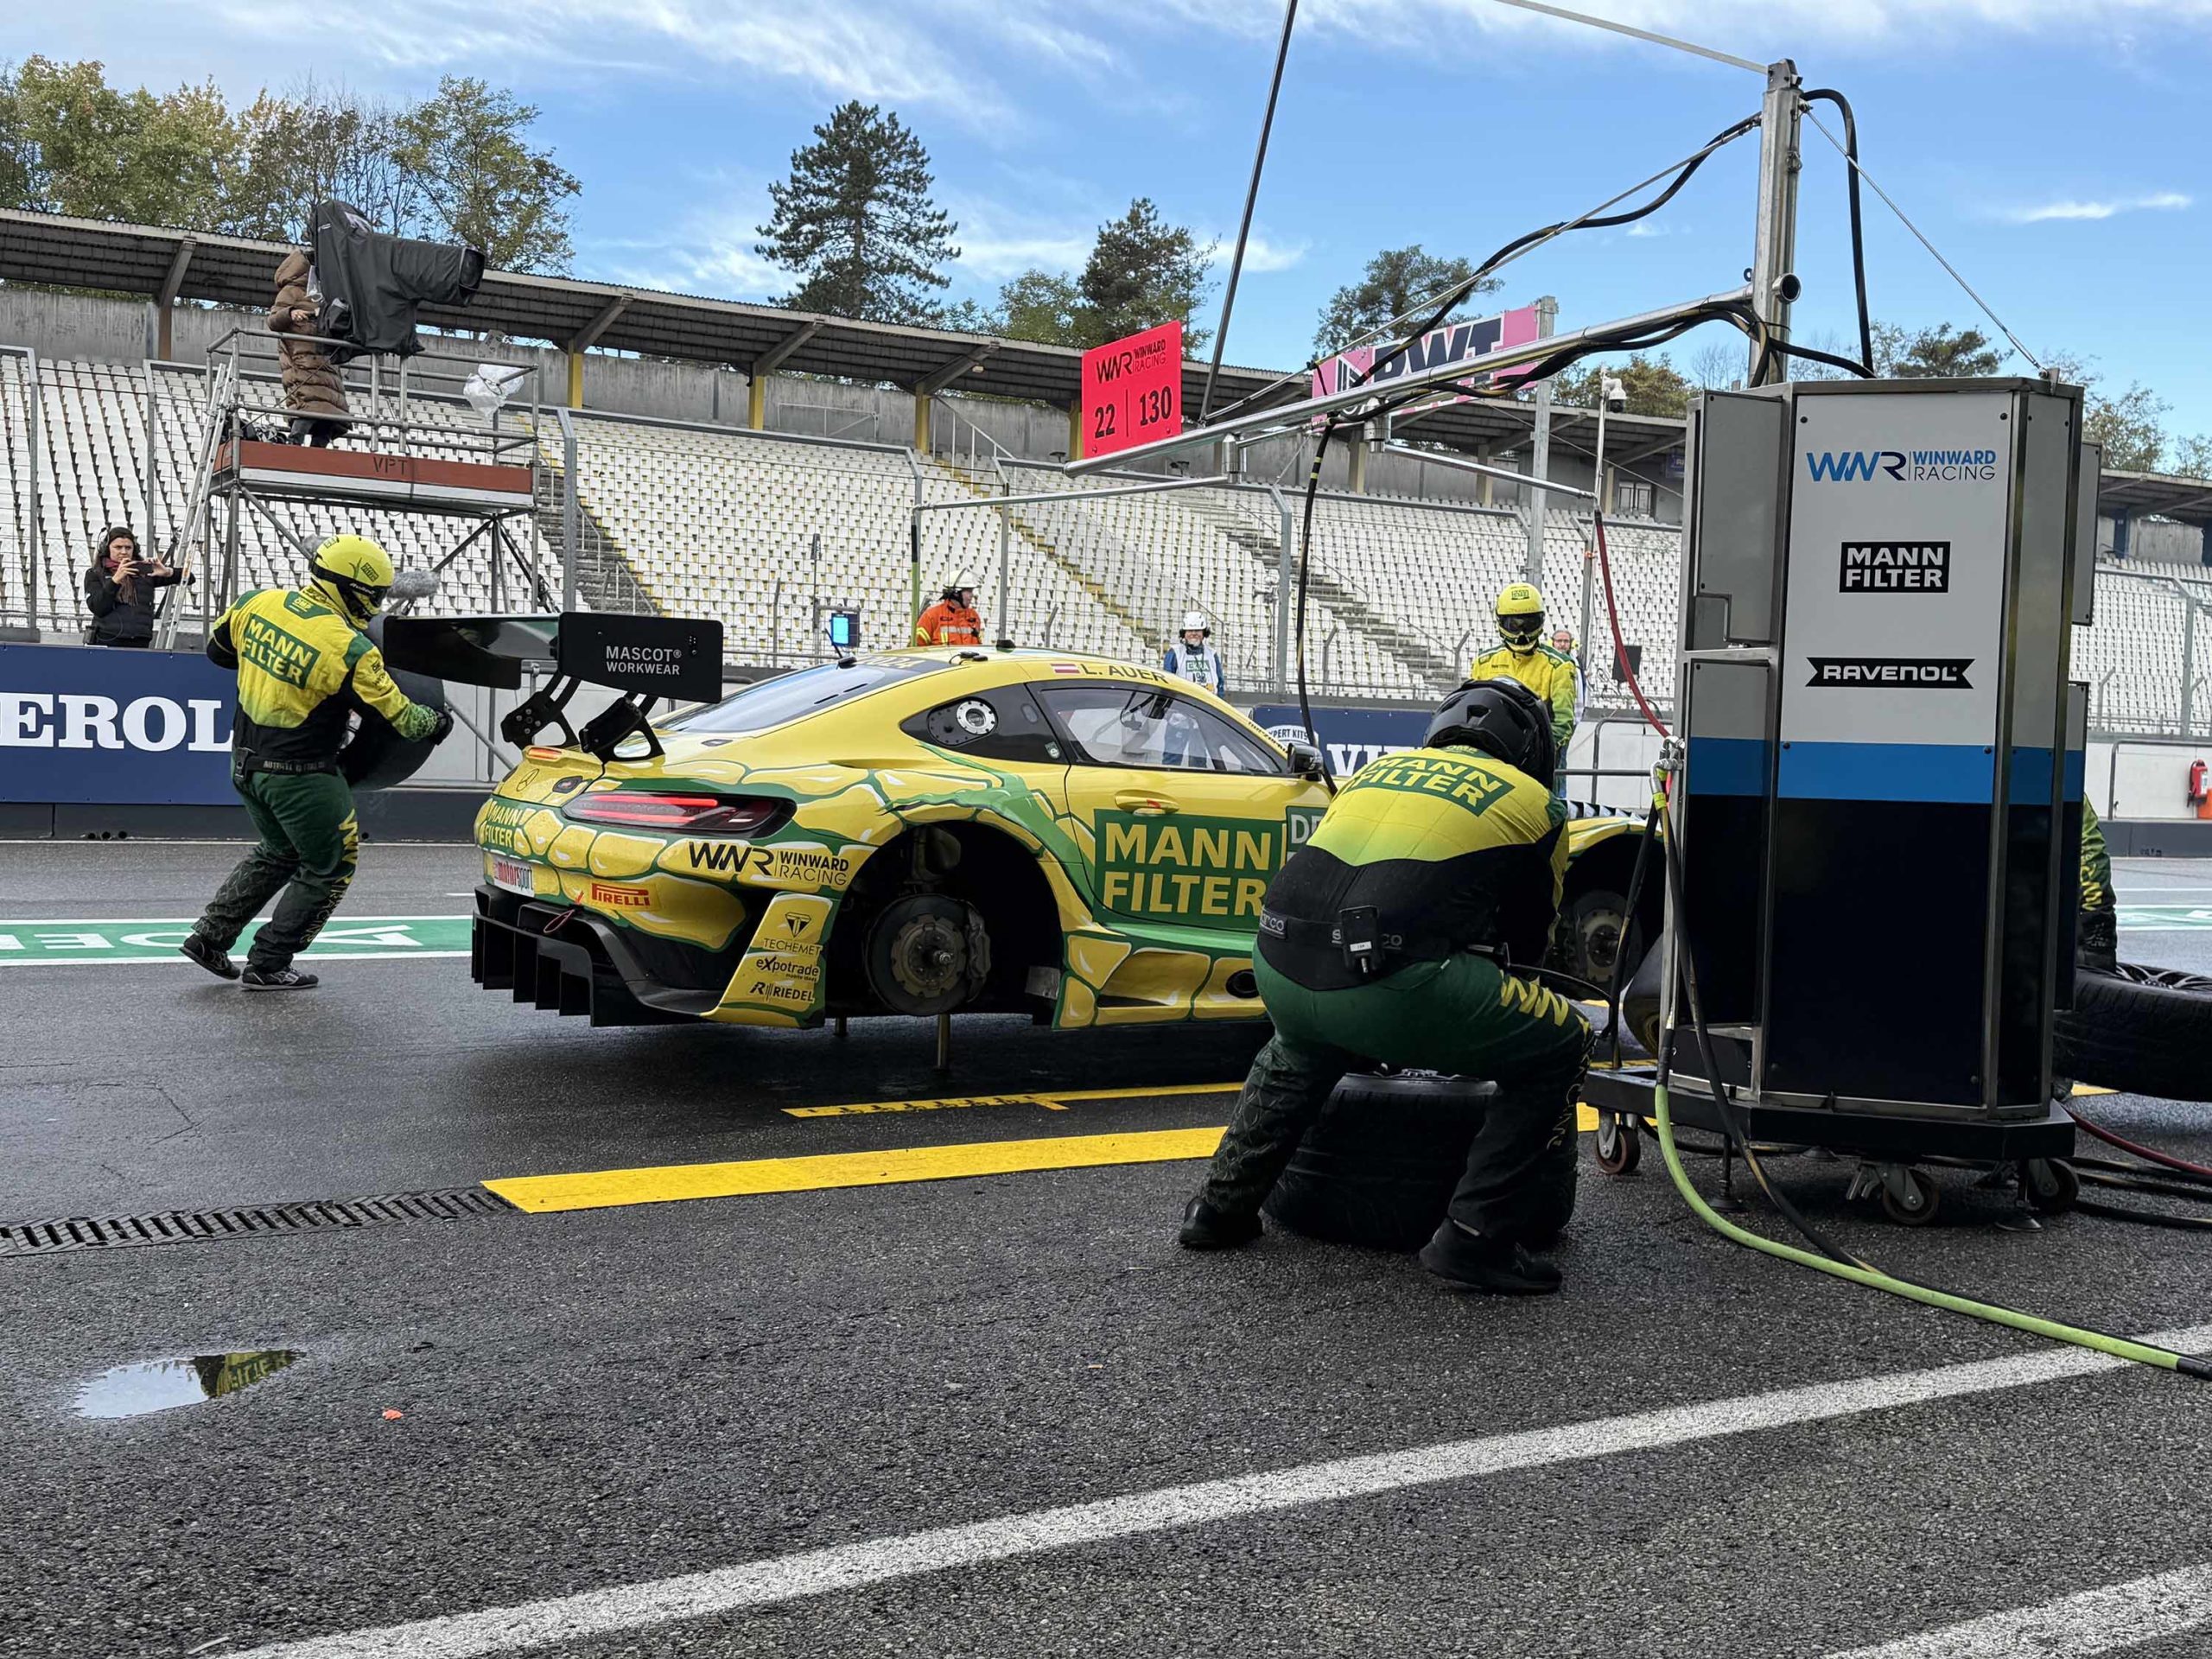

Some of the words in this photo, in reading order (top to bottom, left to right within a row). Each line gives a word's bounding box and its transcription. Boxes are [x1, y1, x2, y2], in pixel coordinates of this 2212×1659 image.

[1134, 339, 1166, 359] WINWARD
[1135, 352, 1166, 372] RACING
[1140, 385, 1173, 426] 130
[1095, 404, 1116, 439] 22
[1912, 449, 1997, 465] WINWARD
[1914, 465, 1996, 481] RACING
[1847, 547, 1943, 566] MANN
[1846, 569, 1943, 588] FILTER
[247, 618, 313, 668] MANN
[242, 637, 303, 685] FILTER
[606, 661, 681, 675] WORKWEAR
[1080, 664, 1103, 676] L.
[1109, 665, 1169, 684] AUER
[1367, 757, 1503, 792] MANN
[1352, 768, 1485, 807] FILTER
[487, 800, 524, 827] MANN
[485, 825, 512, 848] FILTER
[1105, 822, 1271, 871] MANN
[780, 850, 849, 871] WINWARD
[779, 867, 848, 887] RACING
[591, 883, 651, 906] PIRELLI
[1103, 870, 1267, 916] FILTER
[764, 938, 821, 956] TECHEMET
[772, 986, 815, 1001] RIEDEL
